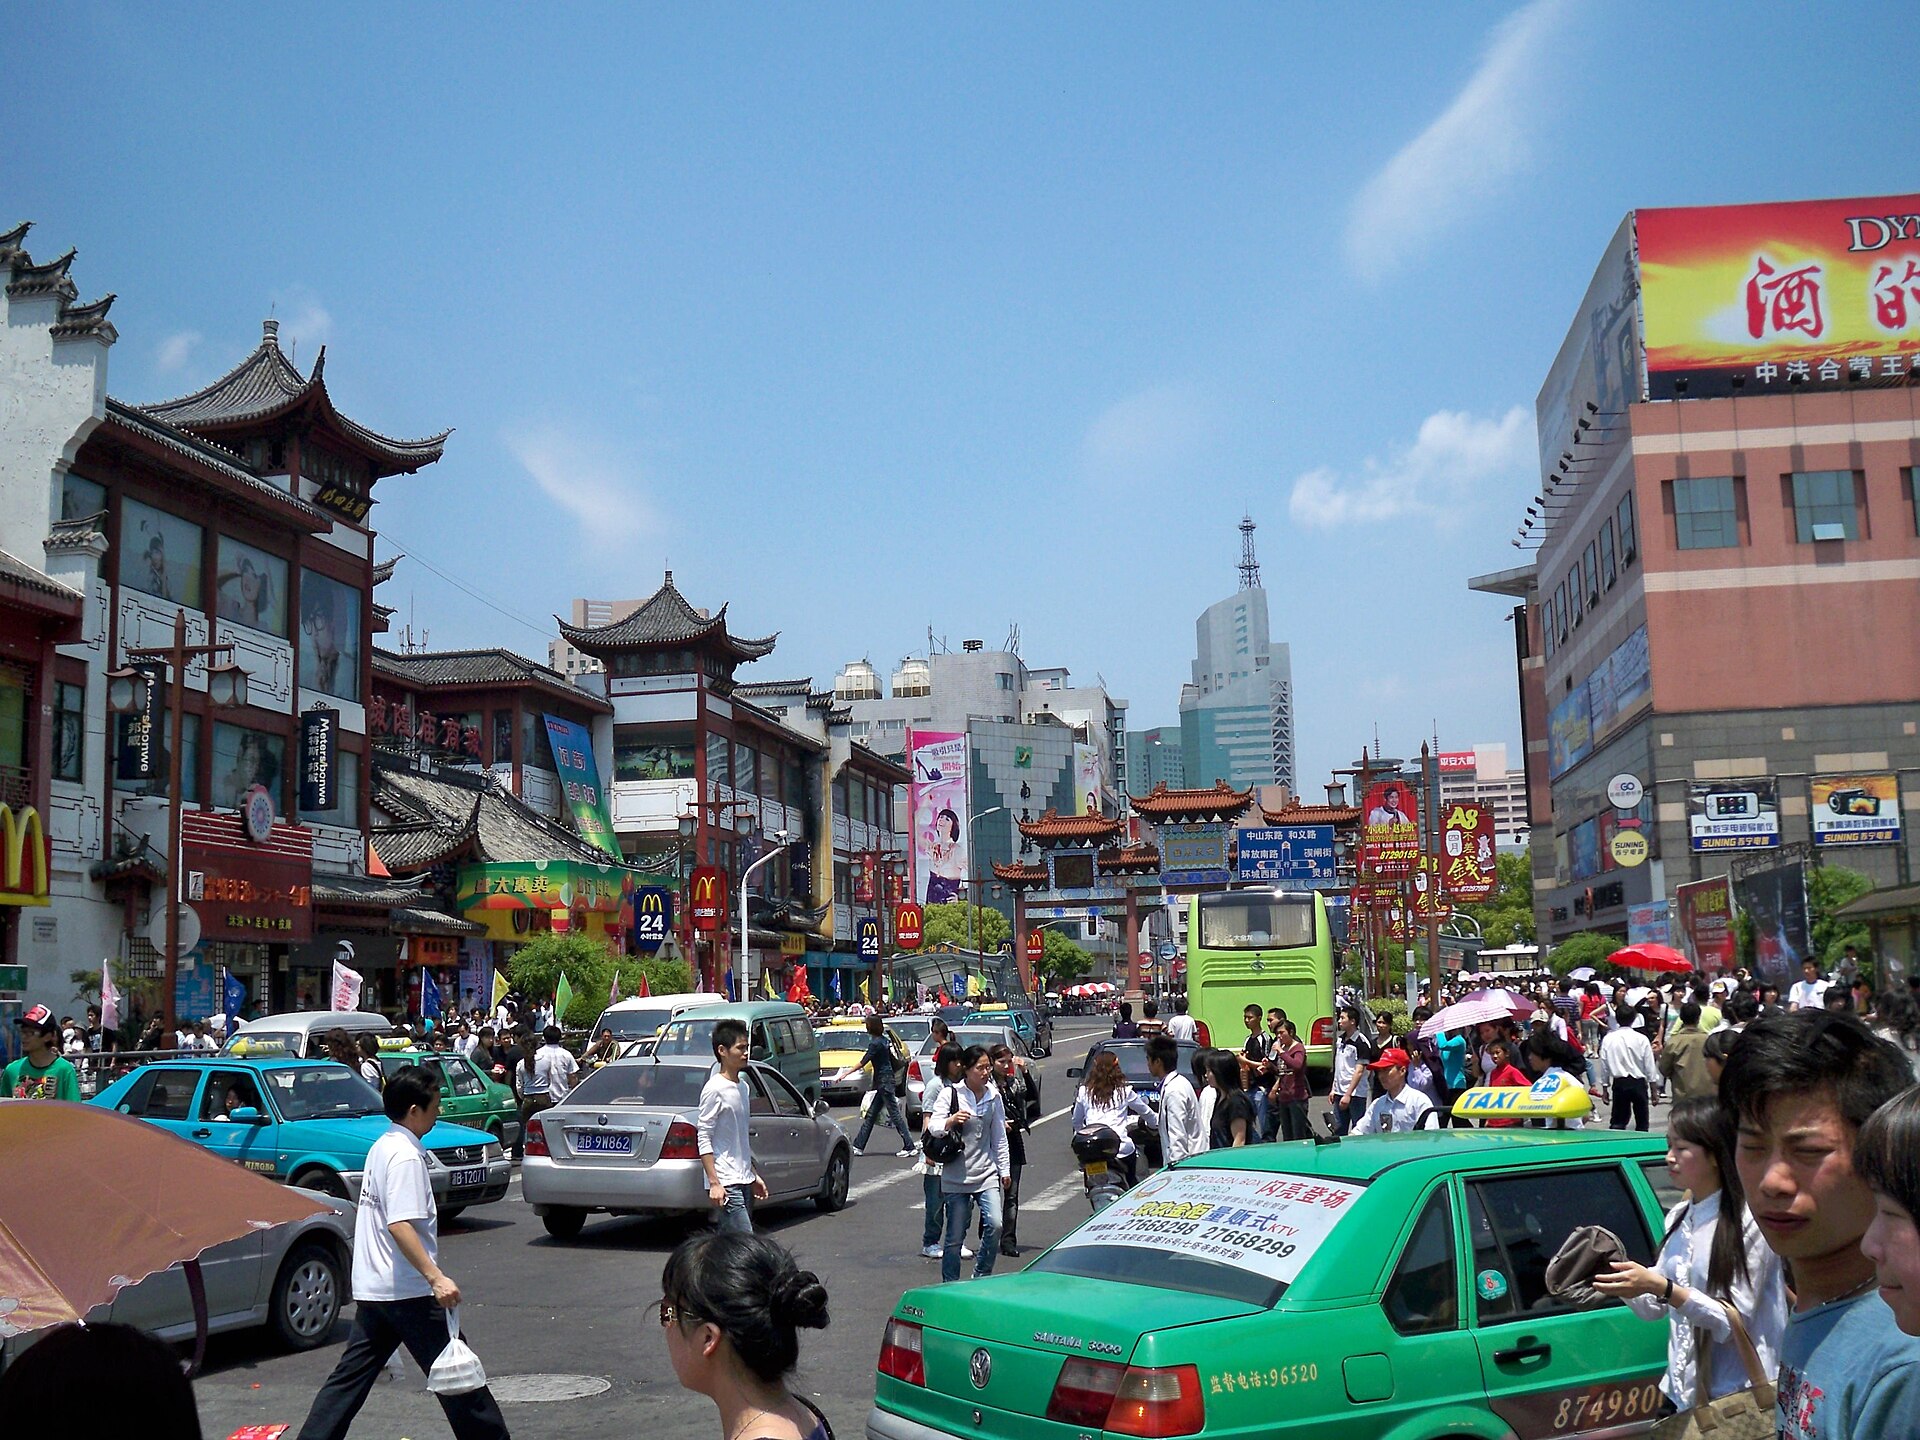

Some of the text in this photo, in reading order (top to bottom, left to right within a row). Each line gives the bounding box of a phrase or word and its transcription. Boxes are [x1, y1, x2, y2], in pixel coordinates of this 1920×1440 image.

[1247, 830, 1316, 840] 中山东路 和义路
[1824, 833, 1859, 842] SUNING
[1702, 838, 1736, 847] SUNING
[1241, 849, 1278, 859] 解放南路
[1241, 870, 1279, 879] 环城西路
[1312, 868, 1332, 878] 灵桥
[640, 914, 664, 931] 24
[862, 937, 878, 949] 24
[261, 1042, 286, 1050] TAXI
[1463, 1092, 1521, 1109] TAXI
[1255, 1178, 1354, 1209] 闪亮登场
[1118, 1219, 1200, 1236] 27668298
[1199, 1227, 1297, 1258] 27668299
[1032, 1331, 1124, 1355] SANTANA 3000
[1210, 1363, 1318, 1394] 监督电话:96520
